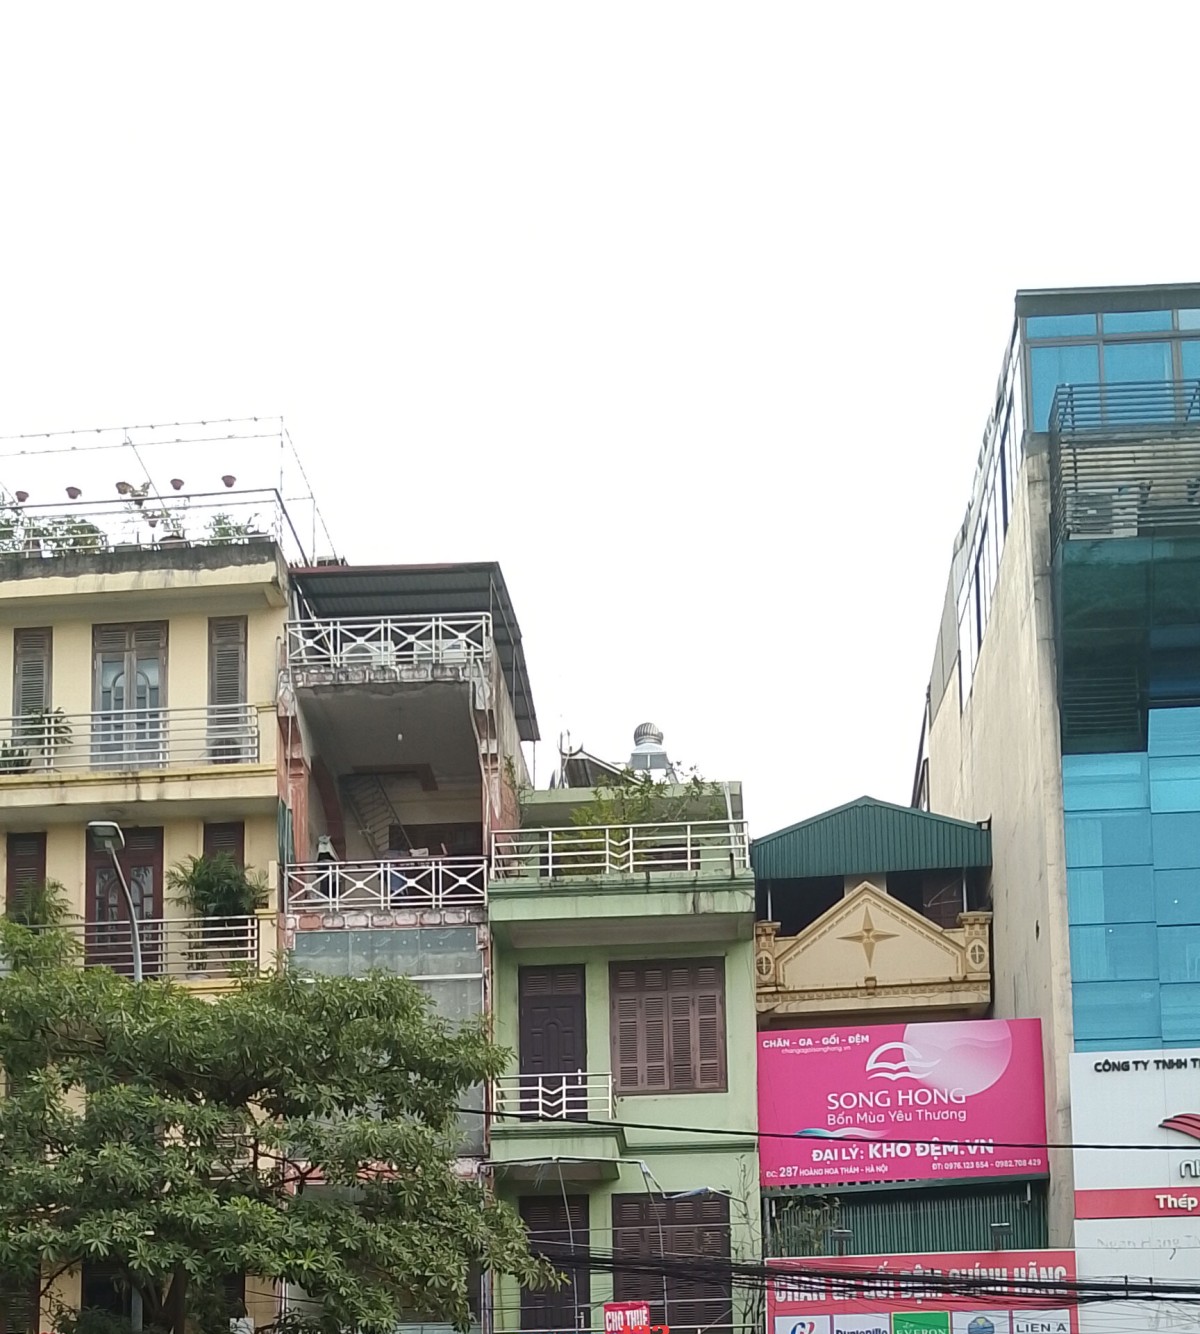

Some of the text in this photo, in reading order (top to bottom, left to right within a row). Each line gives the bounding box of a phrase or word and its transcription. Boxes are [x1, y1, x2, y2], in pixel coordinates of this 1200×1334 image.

[763, 1033, 870, 1049] CHĂN GA GỐI ĐỆM
[1094, 1059, 1130, 1073] CÔNG
[1132, 1060, 1150, 1072] TY
[1153, 1058, 1188, 1070] TNHH
[827, 1087, 967, 1110] SONG HONG
[827, 1109, 967, 1126] Bốn Mùa Yêu Thương
[811, 1148, 839, 1165] ĐẠI
[869, 1142, 911, 1159] KHO
[915, 1137, 994, 1160] ĐỆM.VN
[779, 1166, 799, 1177] 287
[800, 1166, 824, 1177] HOÀNG
[824, 1168, 839, 1176] HOA
[1155, 1194, 1199, 1211] Thép
[606, 1311, 624, 1332] CHO
